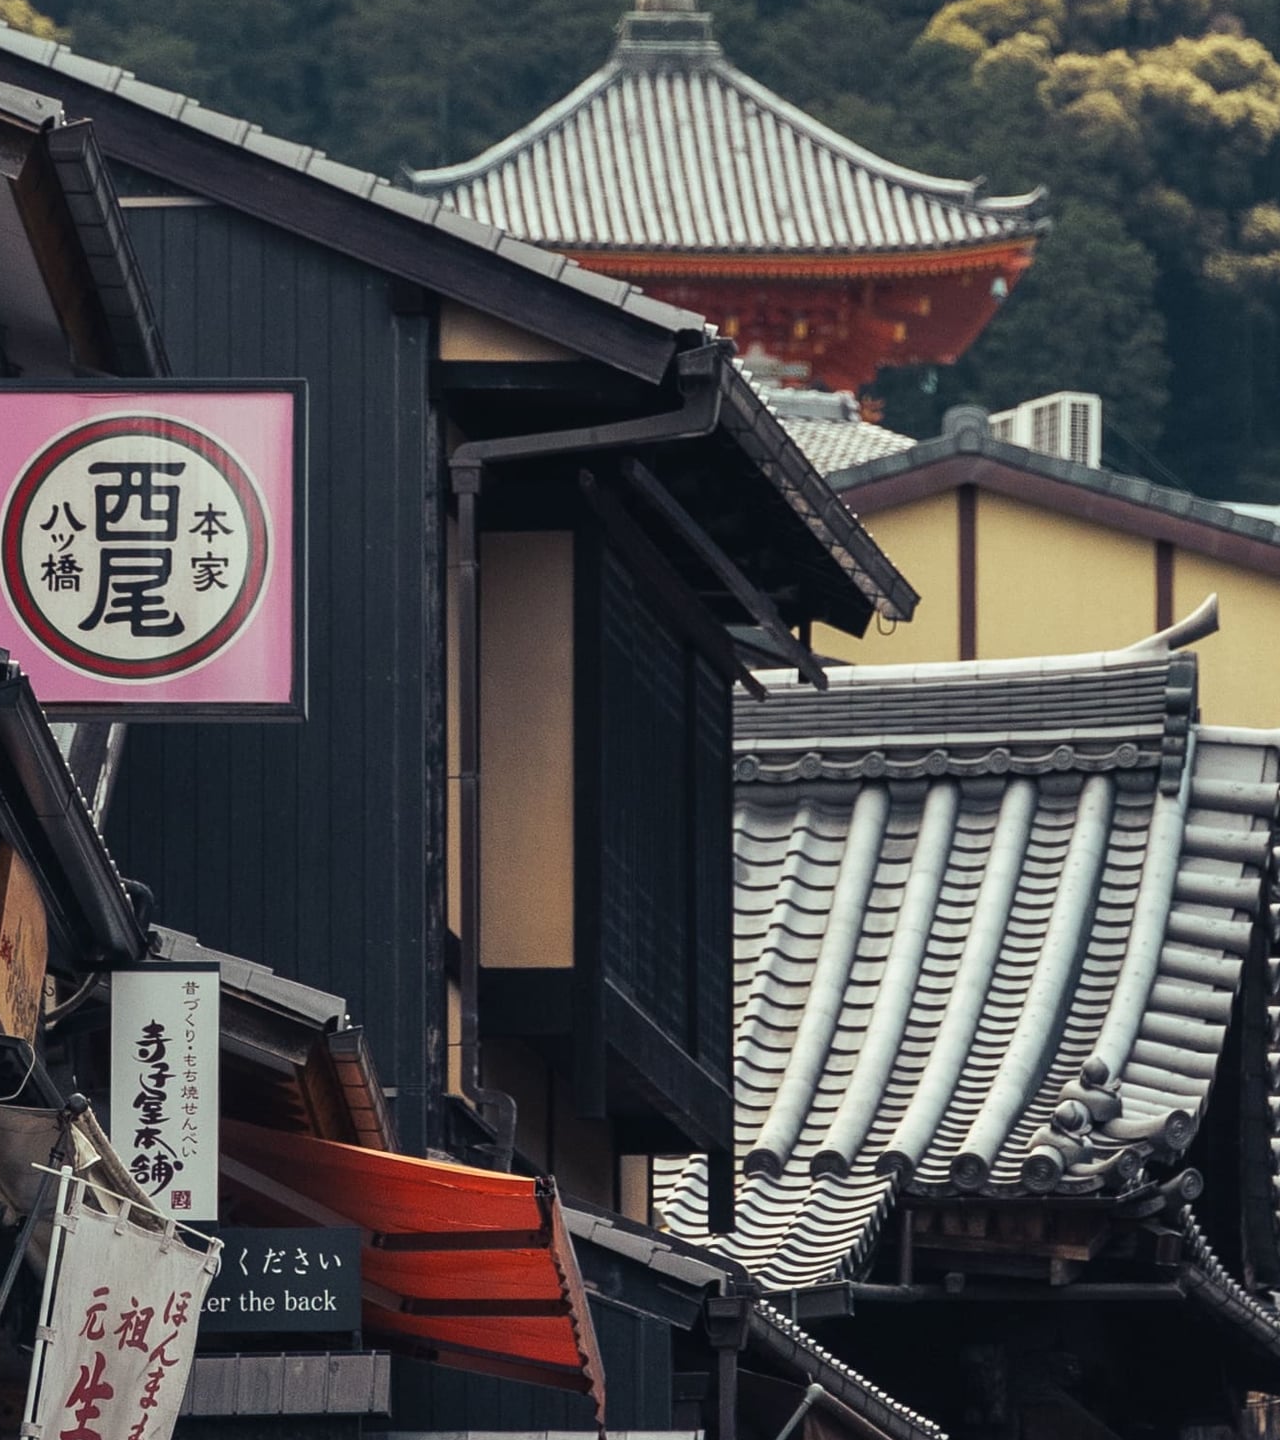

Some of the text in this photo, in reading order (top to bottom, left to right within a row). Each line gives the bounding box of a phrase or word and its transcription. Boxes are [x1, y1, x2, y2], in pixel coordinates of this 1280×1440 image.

[39, 501, 87, 592] 八ツ橋
[78, 461, 186, 638] 西尾
[188, 502, 234, 592] 本家
[129, 1018, 185, 1198] 寺子屋本舗
[216, 1246, 342, 1278] ください
[240, 1290, 276, 1312] the
[284, 1289, 338, 1312] back
